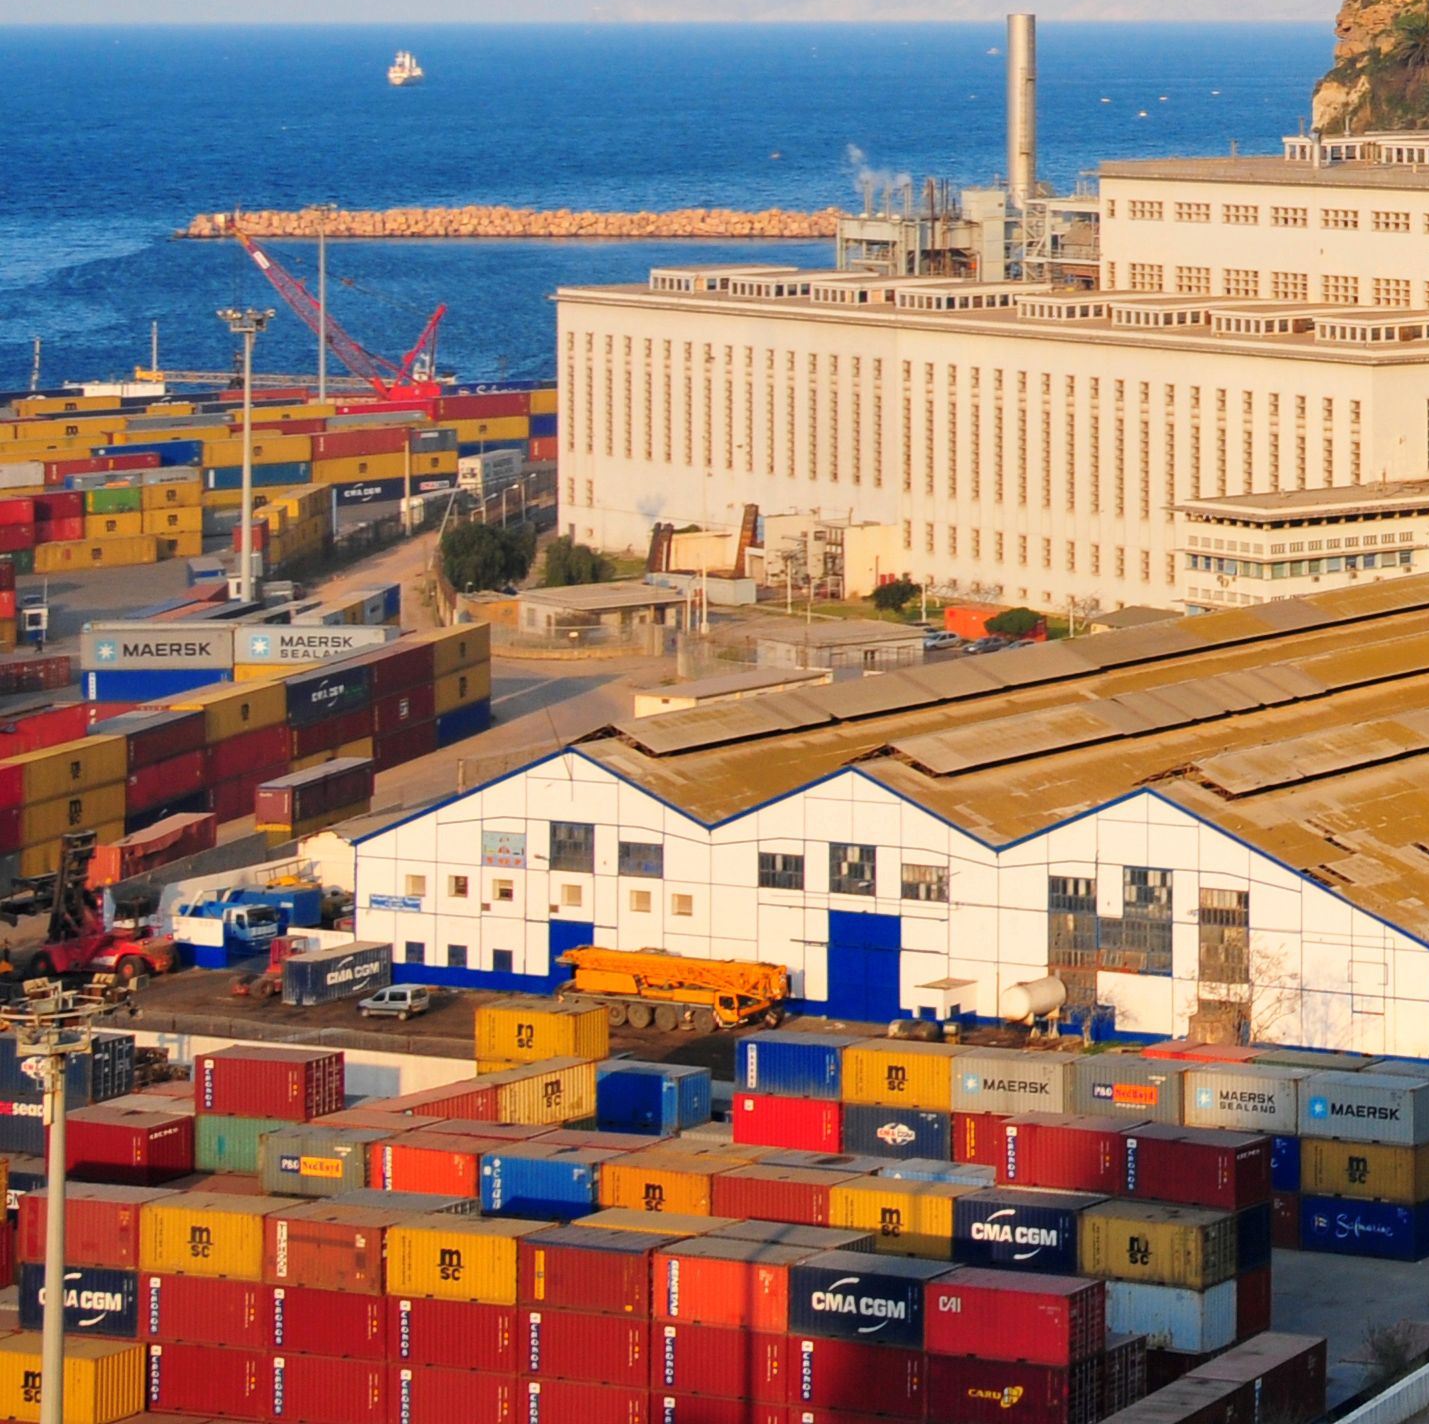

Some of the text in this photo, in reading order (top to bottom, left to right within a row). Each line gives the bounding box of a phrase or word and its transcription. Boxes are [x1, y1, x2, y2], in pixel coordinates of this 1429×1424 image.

[123, 642, 211, 657] MAERSK
[281, 636, 353, 648] MAERSK
[326, 961, 380, 986] CMA CGM
[983, 1078, 1049, 1095] MAERSK
[1220, 1090, 1275, 1104] MAERSK
[1220, 1103, 1276, 1114] SEALAND
[1330, 1102, 1400, 1121] MAERSK
[971, 1222, 1058, 1247] CMA CGM
[39, 1287, 122, 1312] CA CGM
[811, 1291, 906, 1320] CMA CGM
[938, 1295, 962, 1313] CAI
[967, 1388, 1002, 1400] CARU
